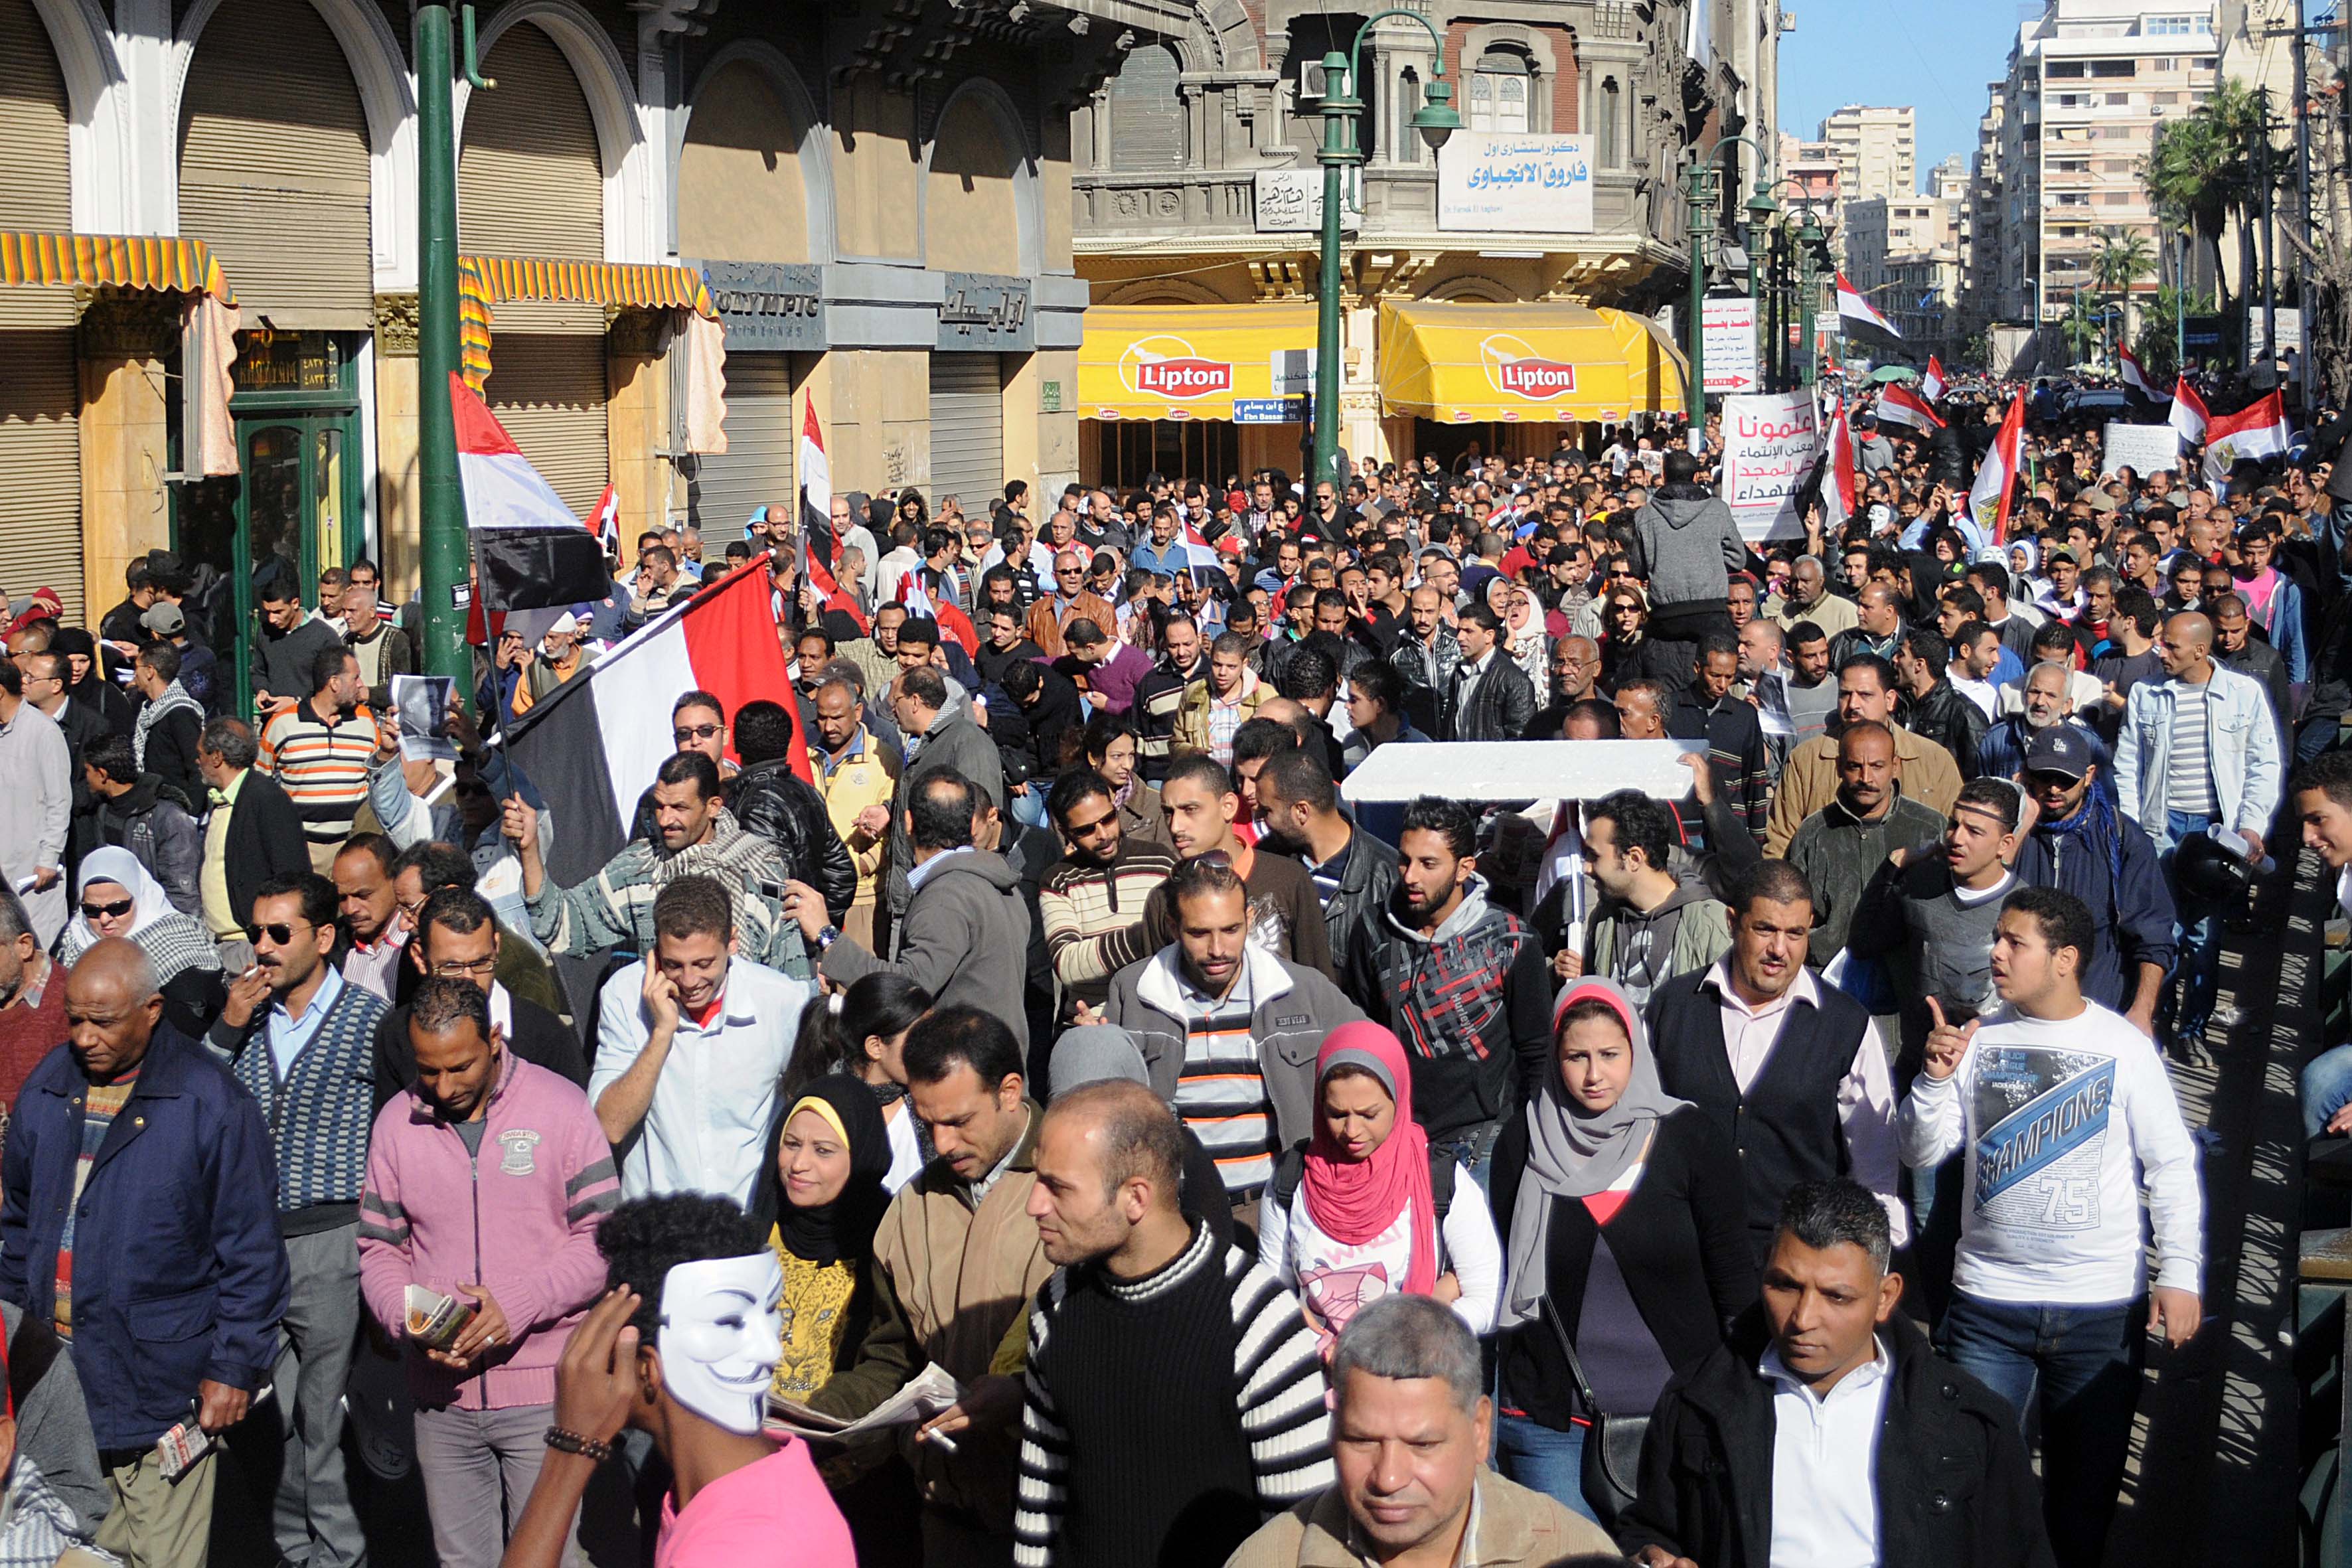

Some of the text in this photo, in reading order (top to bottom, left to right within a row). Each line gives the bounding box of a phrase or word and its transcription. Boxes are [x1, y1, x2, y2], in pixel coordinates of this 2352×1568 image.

[1543, 160, 1588, 189] فاروق
[716, 289, 819, 317] OLYMPIC
[1144, 366, 1225, 391] Lipton
[1505, 366, 1571, 390] Lipton
[1244, 401, 1298, 412] شارع ابن بسام
[1738, 412, 1812, 443] علمونا
[1739, 460, 1791, 481] المجد
[1452, 992, 1474, 1029] Hurley
[2039, 1178, 2090, 1223] 75
